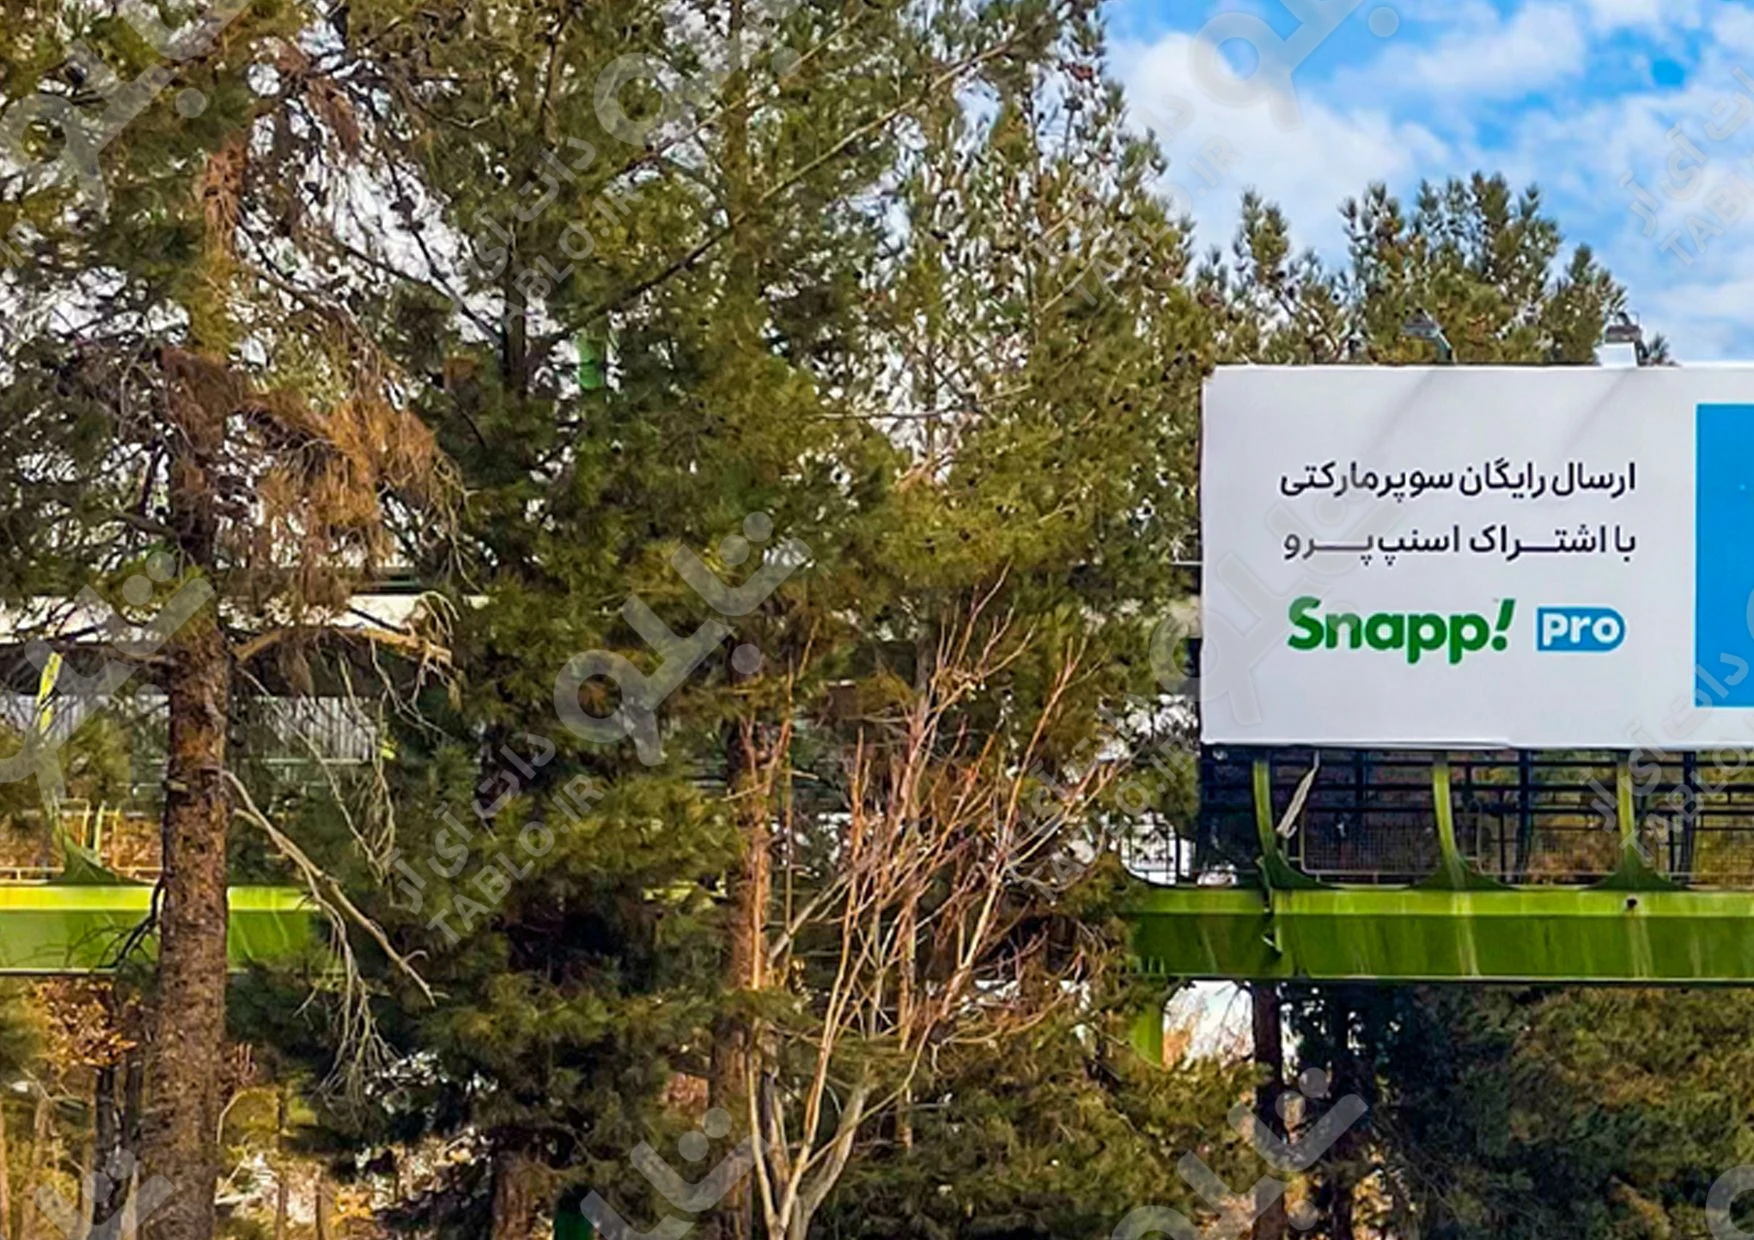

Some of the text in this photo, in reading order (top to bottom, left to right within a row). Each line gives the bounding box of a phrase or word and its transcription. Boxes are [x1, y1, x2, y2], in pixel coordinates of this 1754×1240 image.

[1280, 457, 1636, 503] ارسال رایگان سوپرمارکتی
[1614, 525, 1636, 563] با
[1287, 596, 1517, 665] Snapp!
